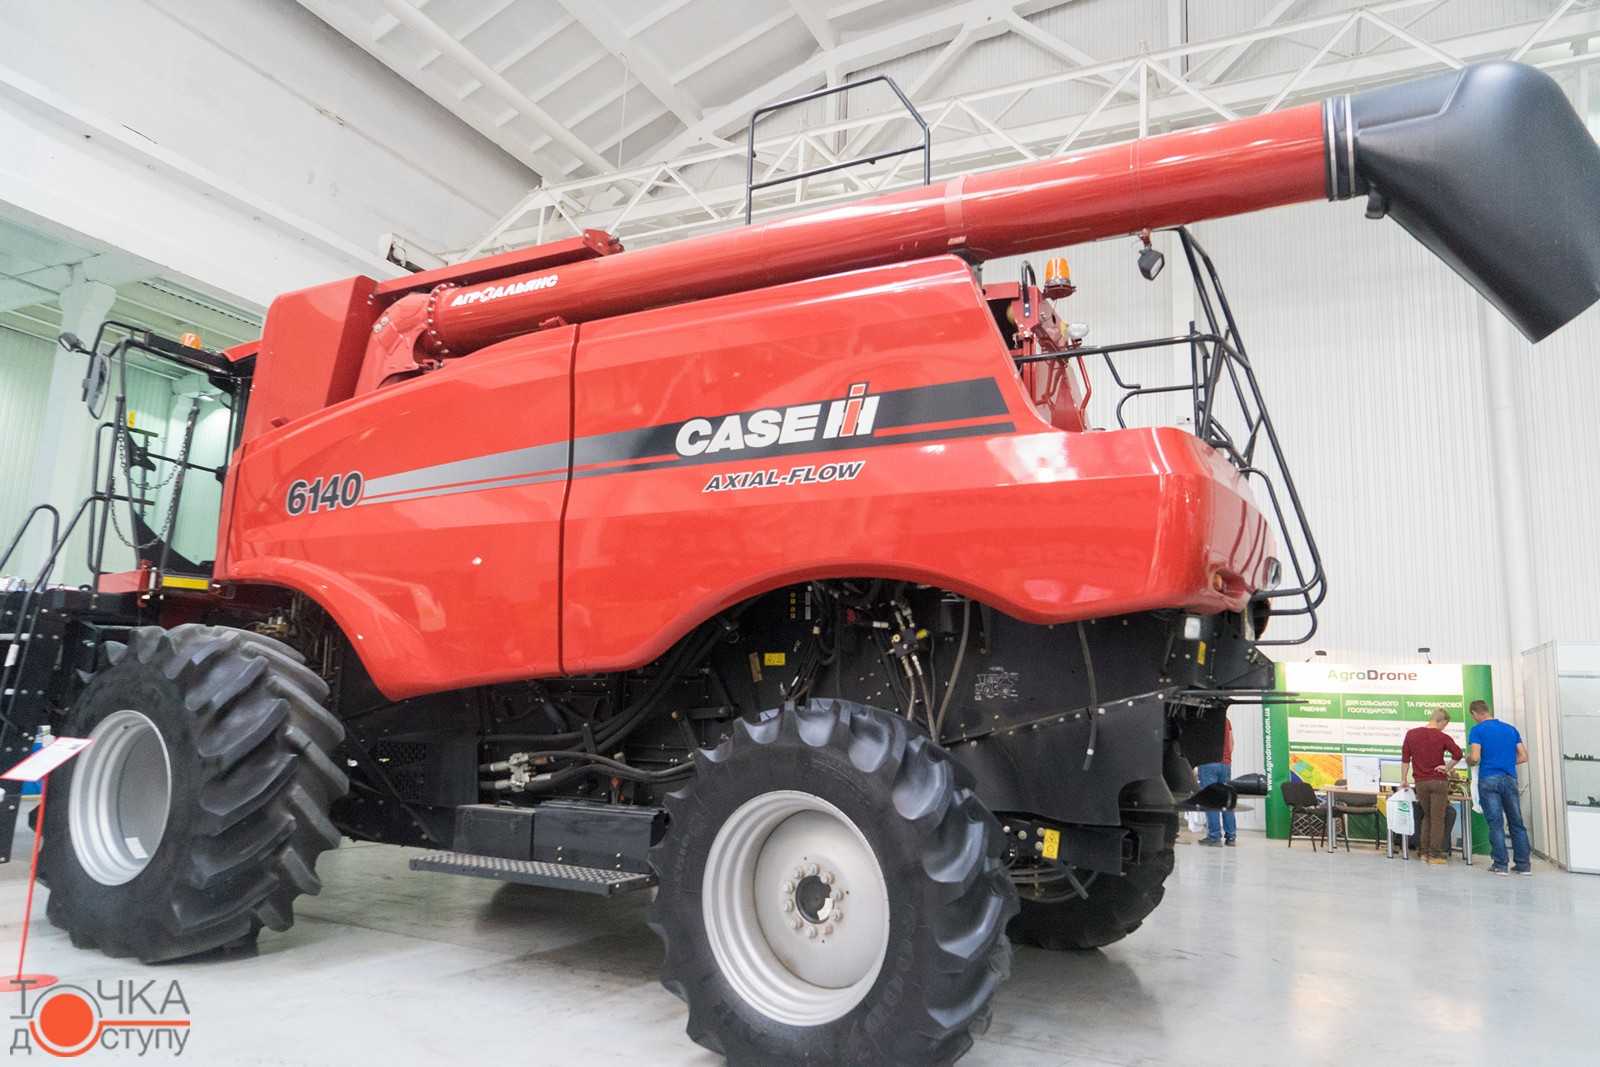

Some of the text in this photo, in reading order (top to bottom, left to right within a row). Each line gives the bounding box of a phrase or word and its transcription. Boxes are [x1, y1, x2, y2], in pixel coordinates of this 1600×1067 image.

[675, 403, 822, 457] CASE
[286, 470, 364, 517] 6140
[702, 460, 866, 493] AXIAL-FLOW
[1328, 669, 1418, 682] AgroDrone
[1264, 707, 1274, 791] www.agrodrone.com.ua
